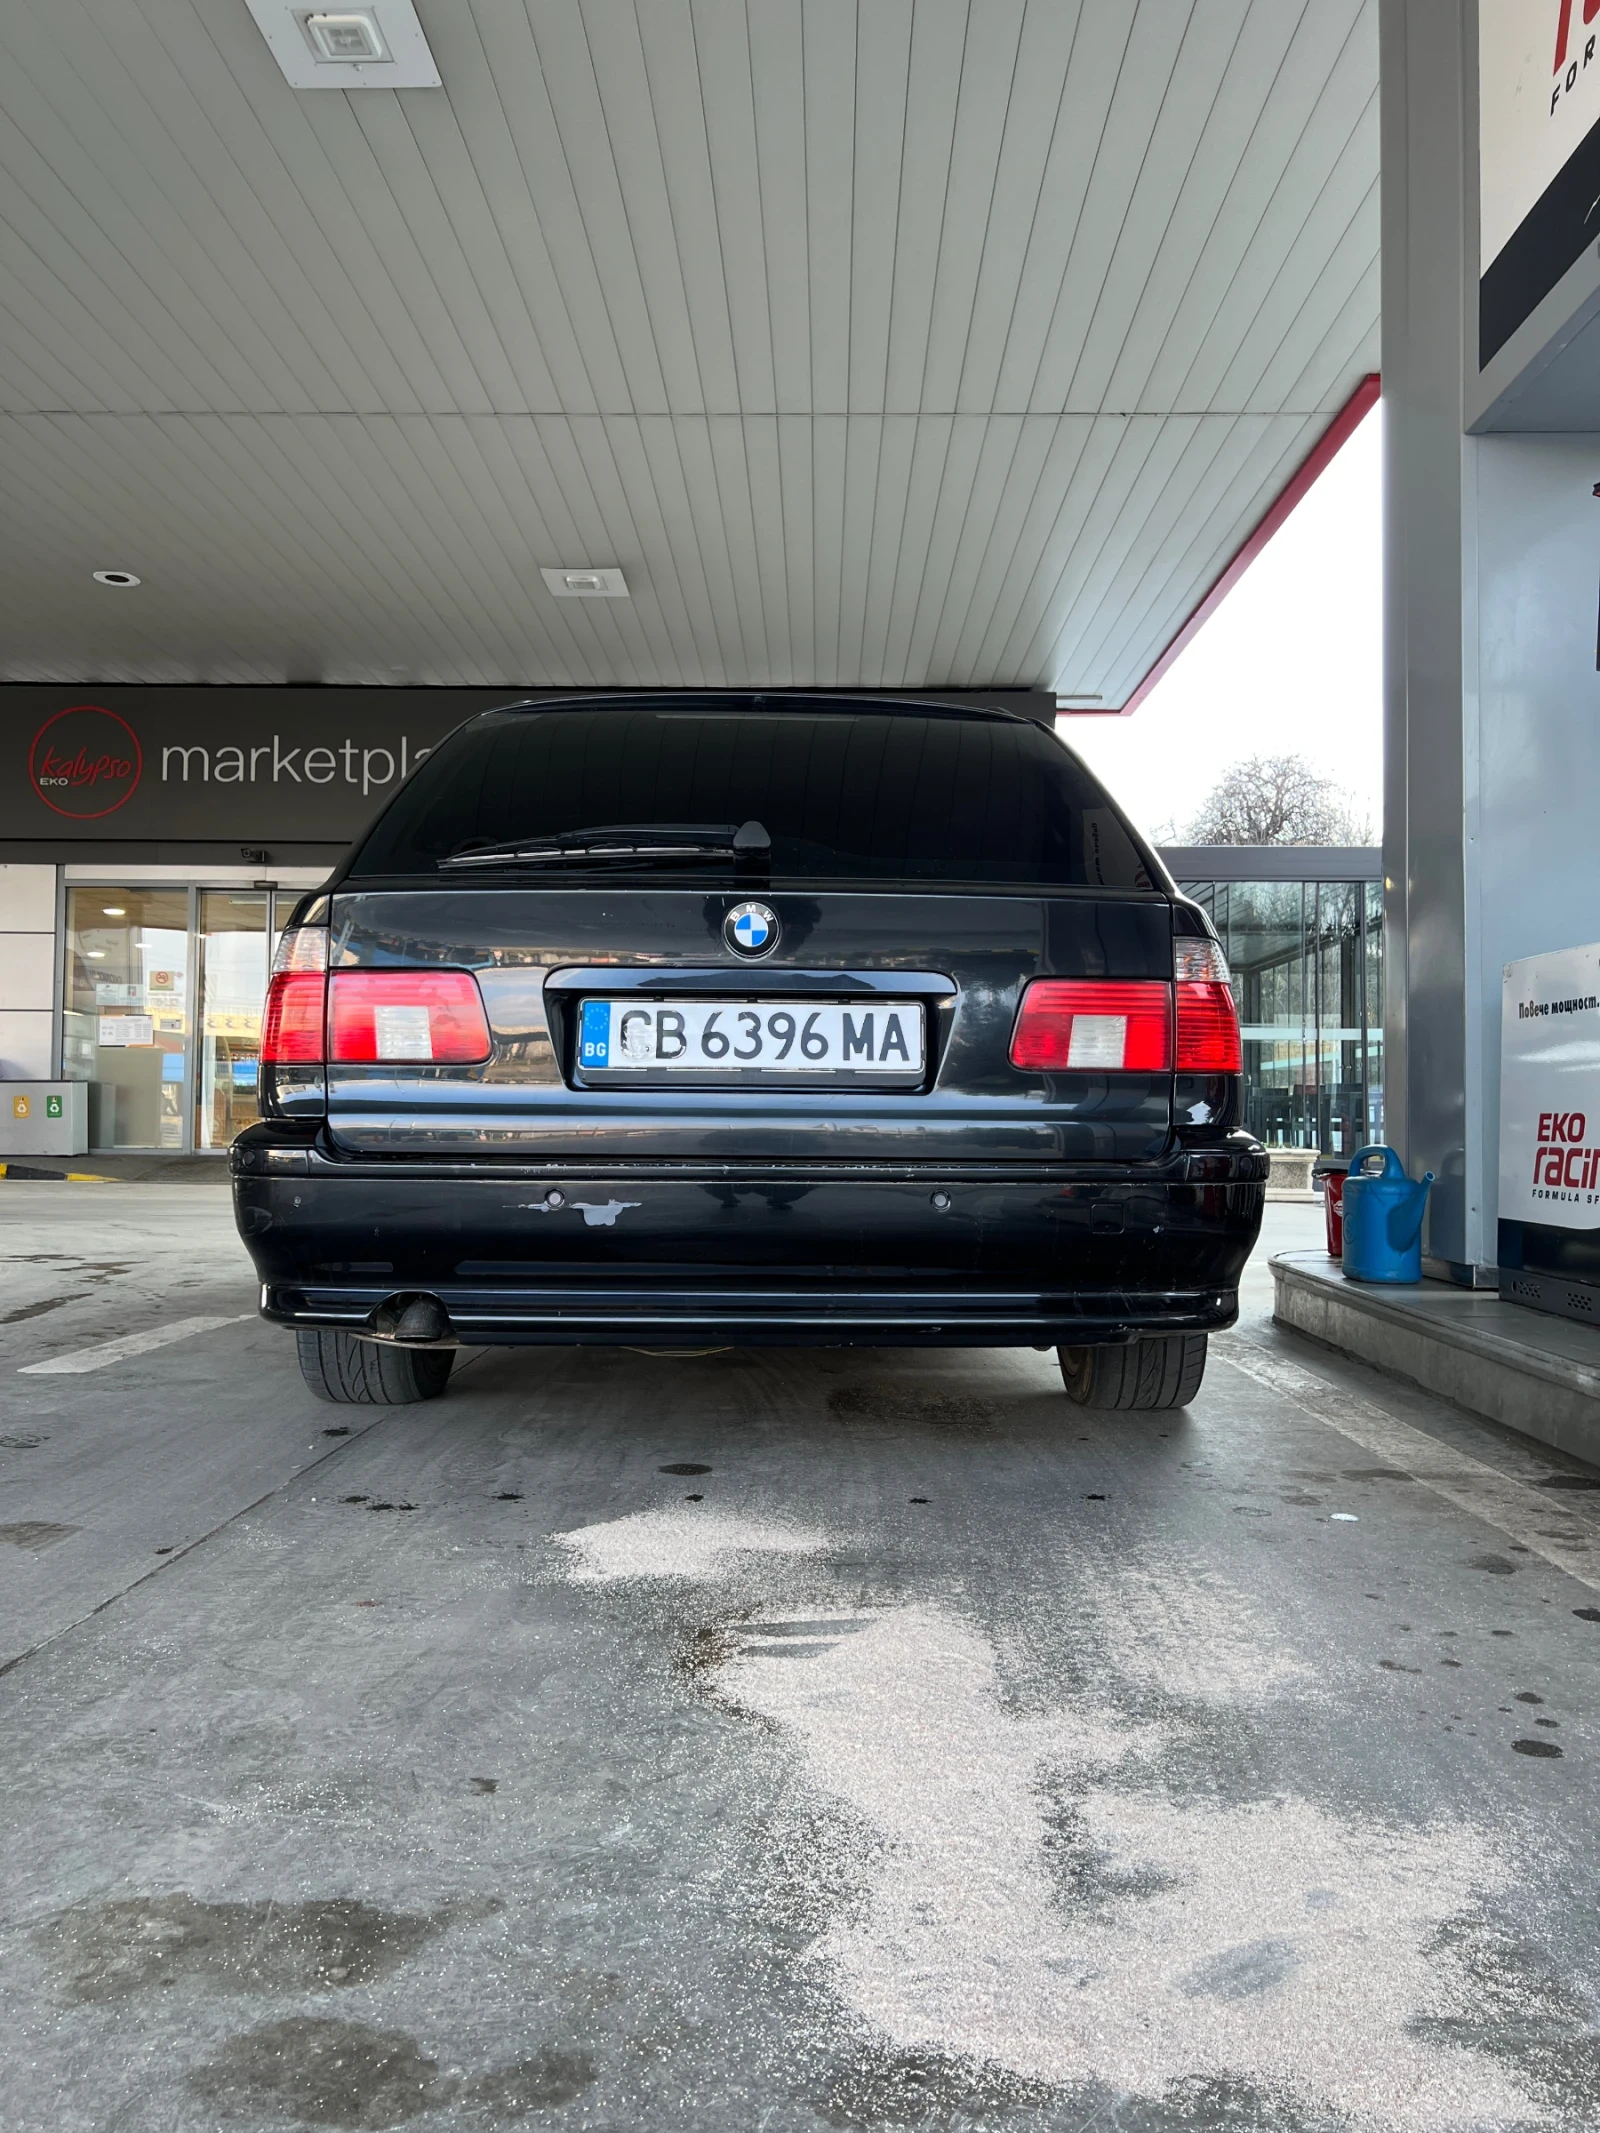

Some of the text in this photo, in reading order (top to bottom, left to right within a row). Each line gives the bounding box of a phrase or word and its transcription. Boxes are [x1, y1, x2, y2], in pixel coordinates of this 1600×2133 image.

[162, 735, 433, 796] marketpl
[40, 777, 68, 786] EKO
[729, 904, 774, 922] BMW
[701, 1011, 829, 1060] 6396
[842, 1012, 910, 1062] MA
[584, 1042, 607, 1057] BG
[1537, 1112, 1586, 1143] EKO
[1532, 1189, 1580, 1203] FORMULA
